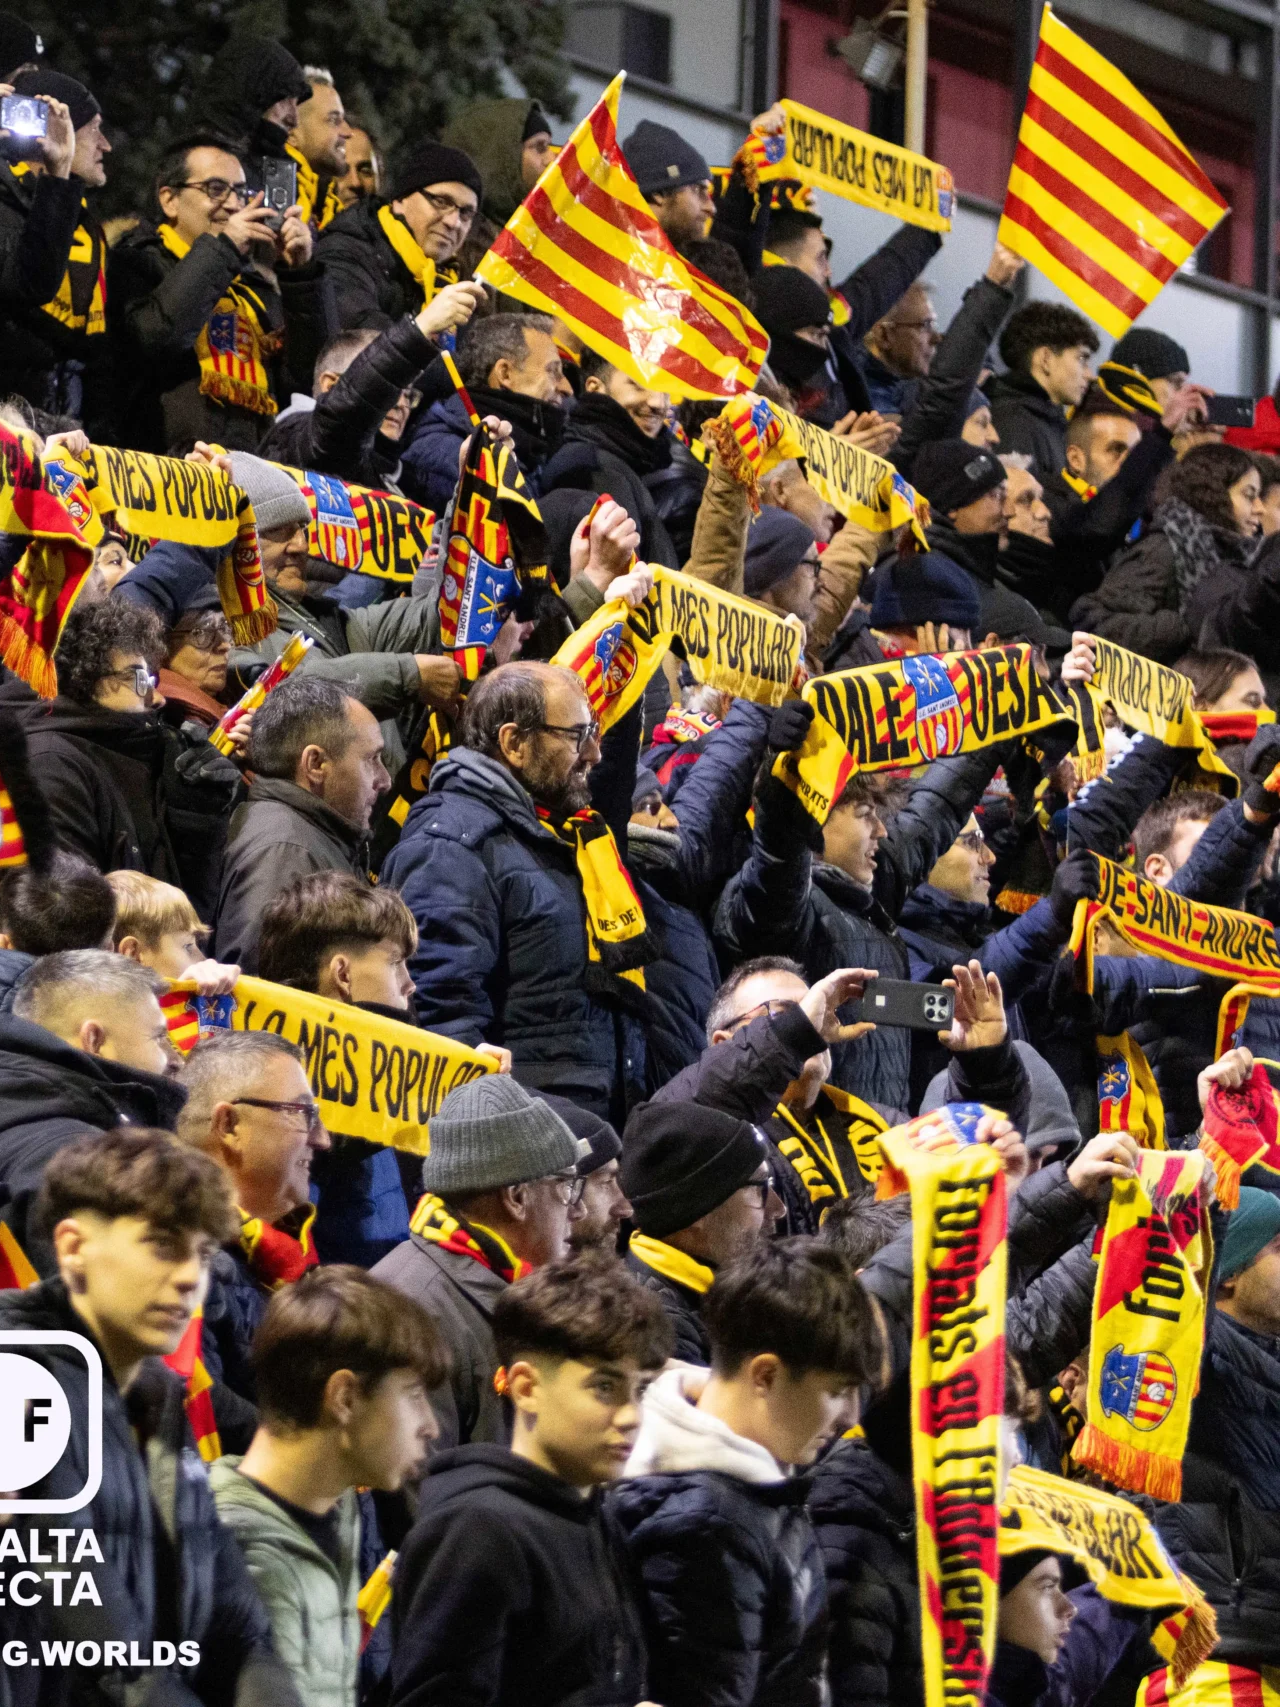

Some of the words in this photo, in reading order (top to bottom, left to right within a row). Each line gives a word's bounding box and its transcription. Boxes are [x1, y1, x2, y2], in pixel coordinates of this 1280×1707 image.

[790, 118, 866, 188] POPULAR
[913, 164, 935, 212] LA
[458, 603, 469, 642] ANDREU
[463, 577, 474, 602] SANT
[716, 602, 796, 684] POPULAR
[813, 671, 911, 764] DALE
[959, 648, 1067, 742] UESA
[598, 917, 618, 932] DES
[619, 908, 637, 927] DE
[1134, 873, 1193, 944] SANT
[930, 1370, 979, 1438] en
